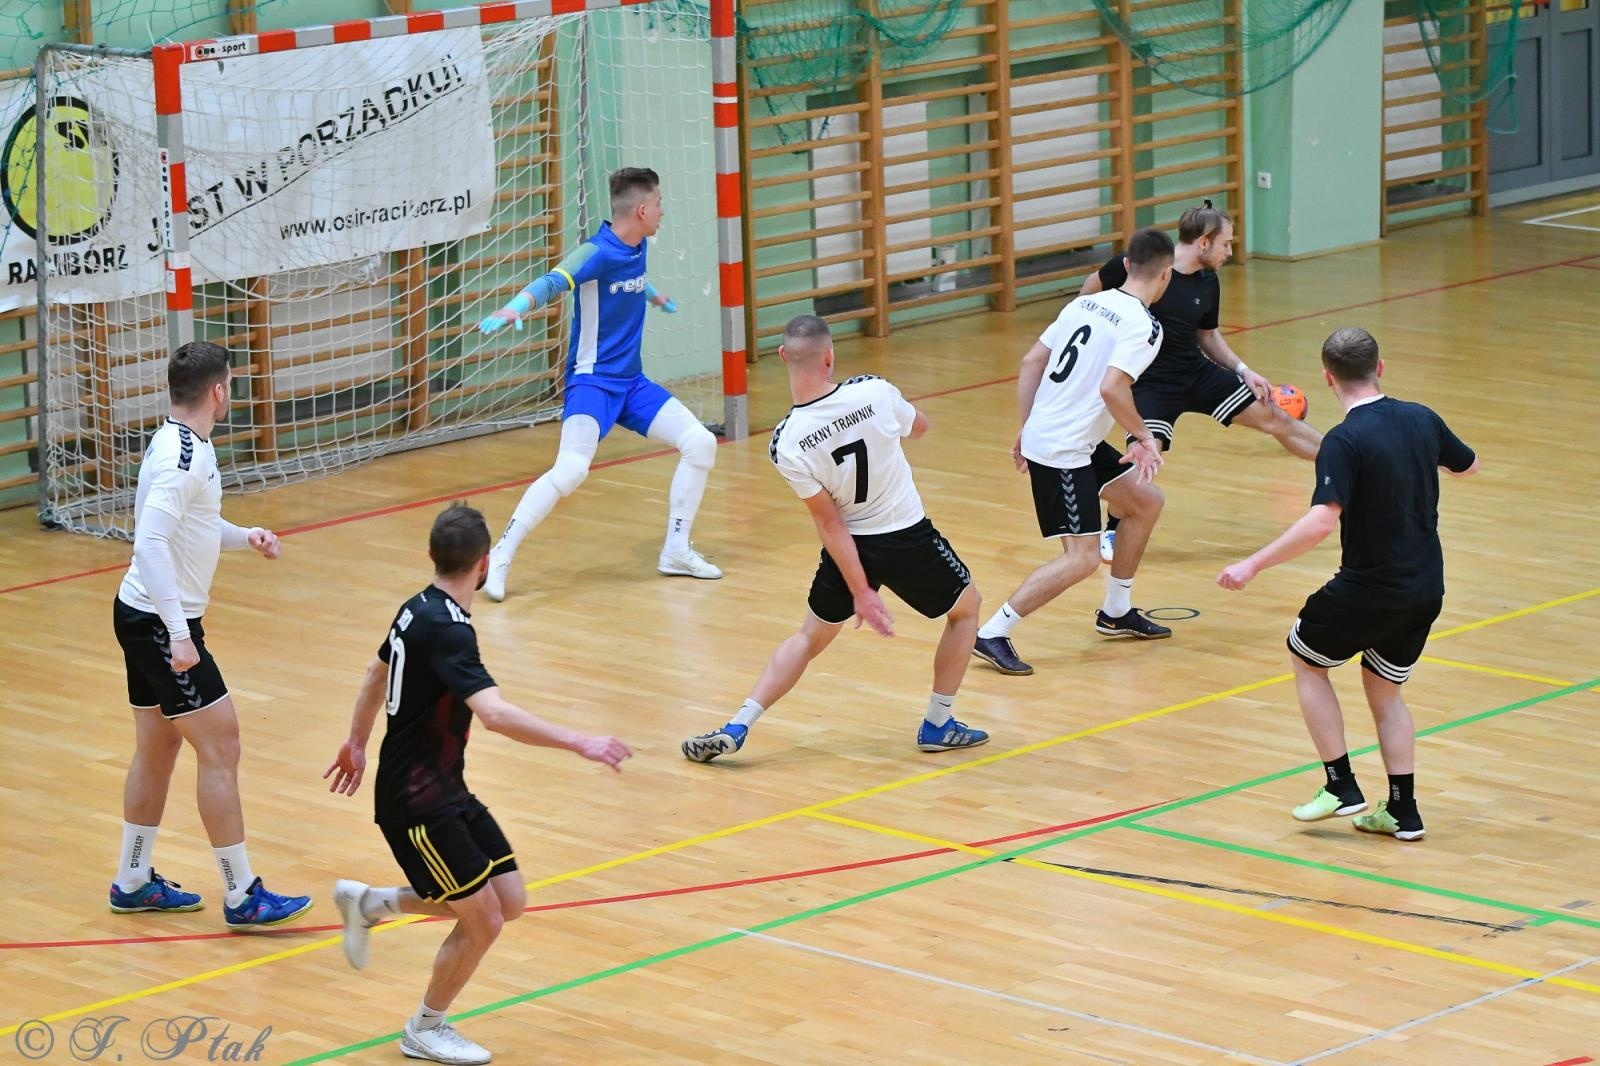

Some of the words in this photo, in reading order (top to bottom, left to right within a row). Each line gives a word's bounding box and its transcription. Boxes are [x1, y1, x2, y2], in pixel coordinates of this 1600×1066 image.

[147, 181, 224, 252] JST
[232, 160, 268, 201] W
[8, 243, 129, 285] RAIBÓRZ
[1049, 324, 1091, 383] 6
[798, 424, 832, 453] PIĘKNY
[832, 404, 876, 433] TRAWNIK
[831, 438, 868, 504] 7
